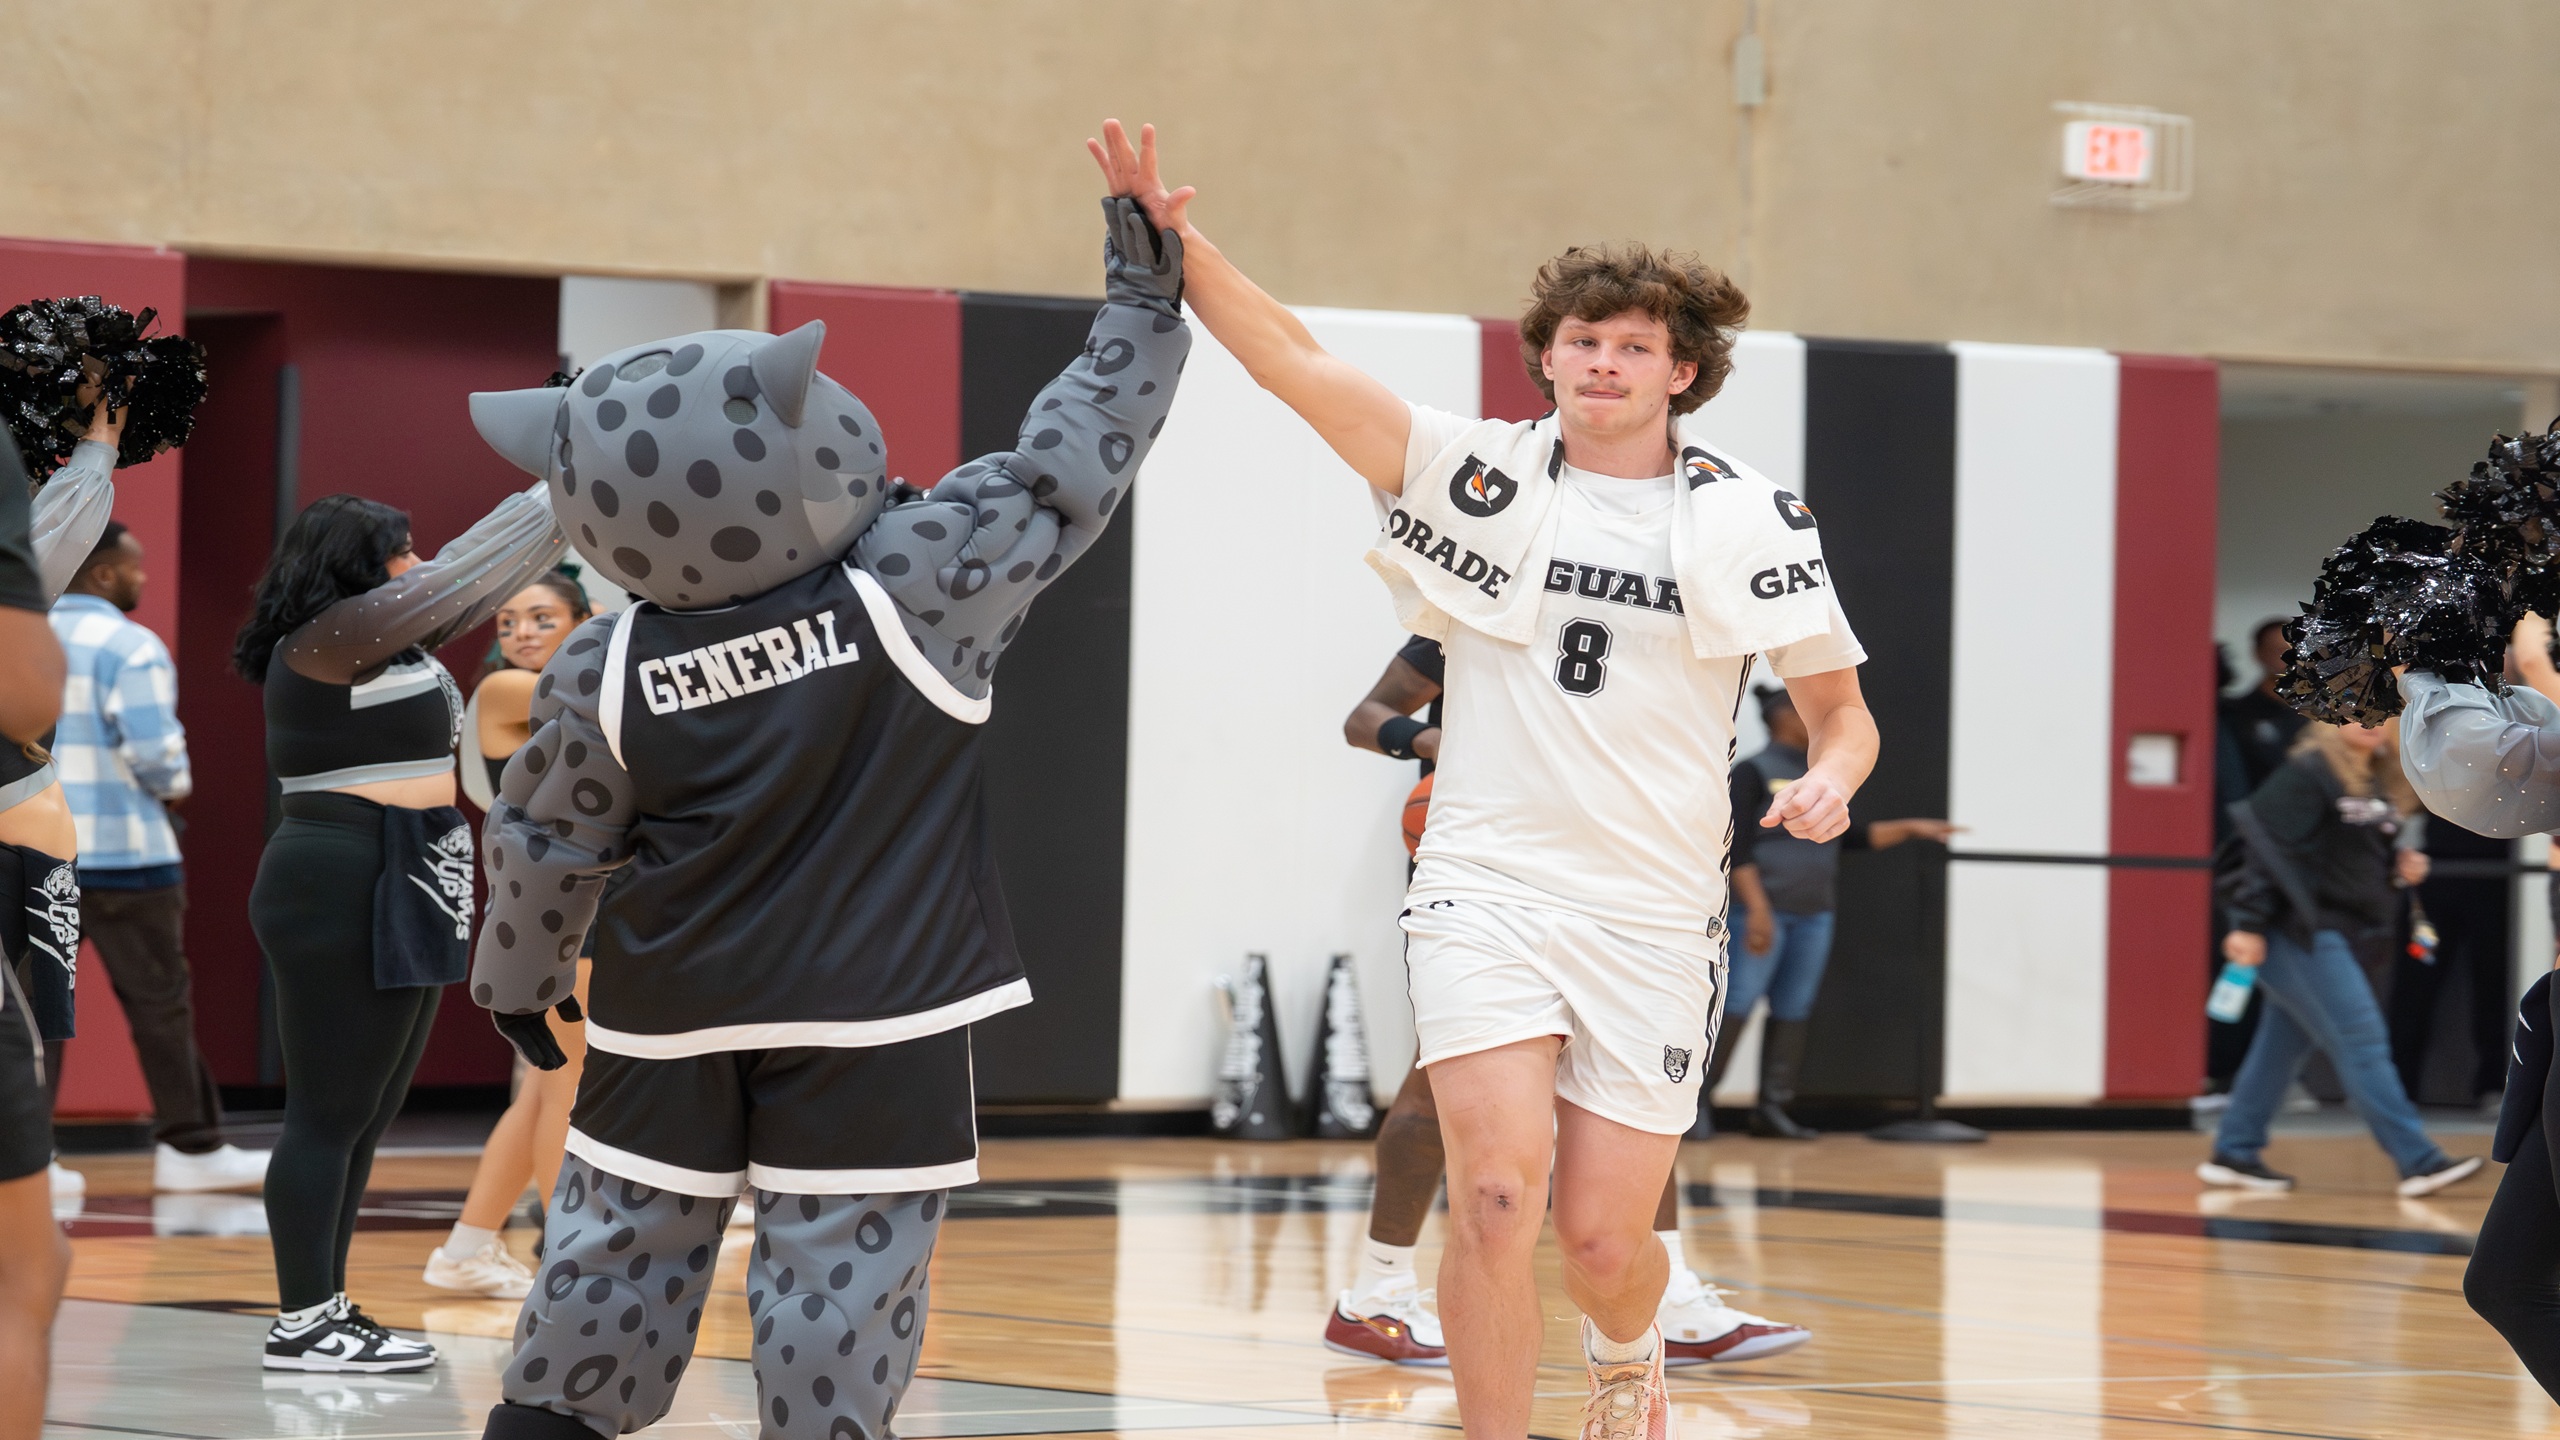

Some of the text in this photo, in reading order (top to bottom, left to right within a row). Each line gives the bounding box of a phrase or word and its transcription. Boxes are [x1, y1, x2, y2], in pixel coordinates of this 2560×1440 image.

[1381, 509, 1511, 599] ORADE
[638, 610, 860, 716] GENERAL
[1553, 617, 1613, 698] 8
[437, 860, 460, 898] UP
[456, 861, 476, 940] PAWS
[48, 904, 66, 944] UP
